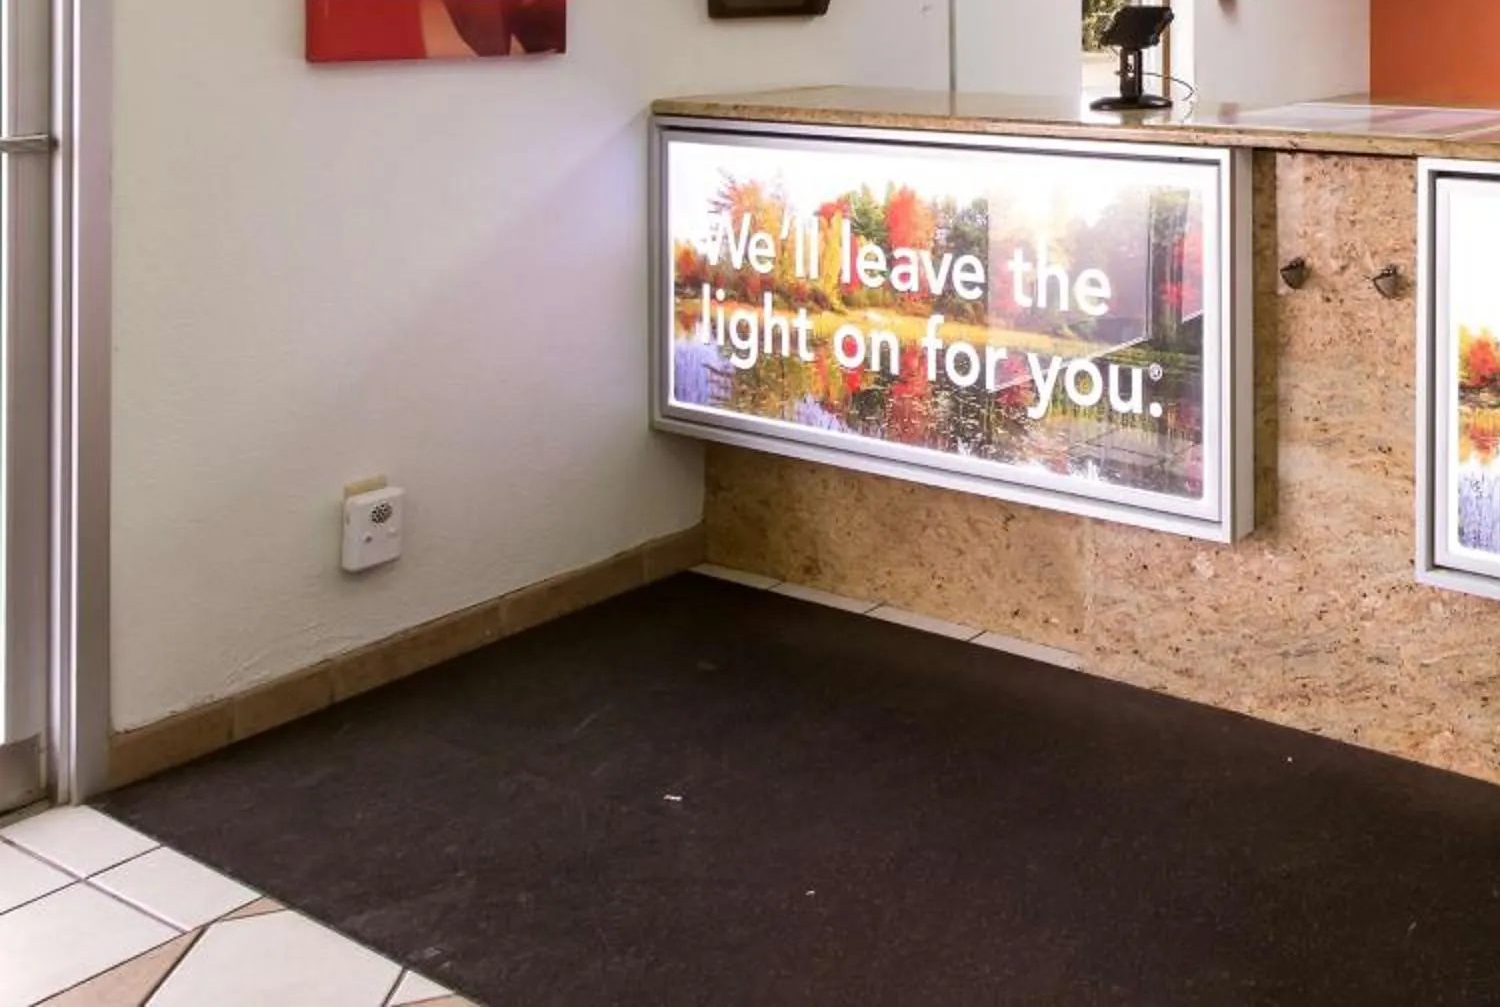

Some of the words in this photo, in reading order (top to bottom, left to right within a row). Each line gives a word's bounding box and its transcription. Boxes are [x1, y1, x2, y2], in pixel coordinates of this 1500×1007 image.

[699, 207, 819, 279] We'll
[842, 217, 986, 301] leave
[1007, 233, 1113, 316] the
[702, 282, 816, 370] light
[833, 323, 900, 376] on
[920, 313, 1009, 391] for
